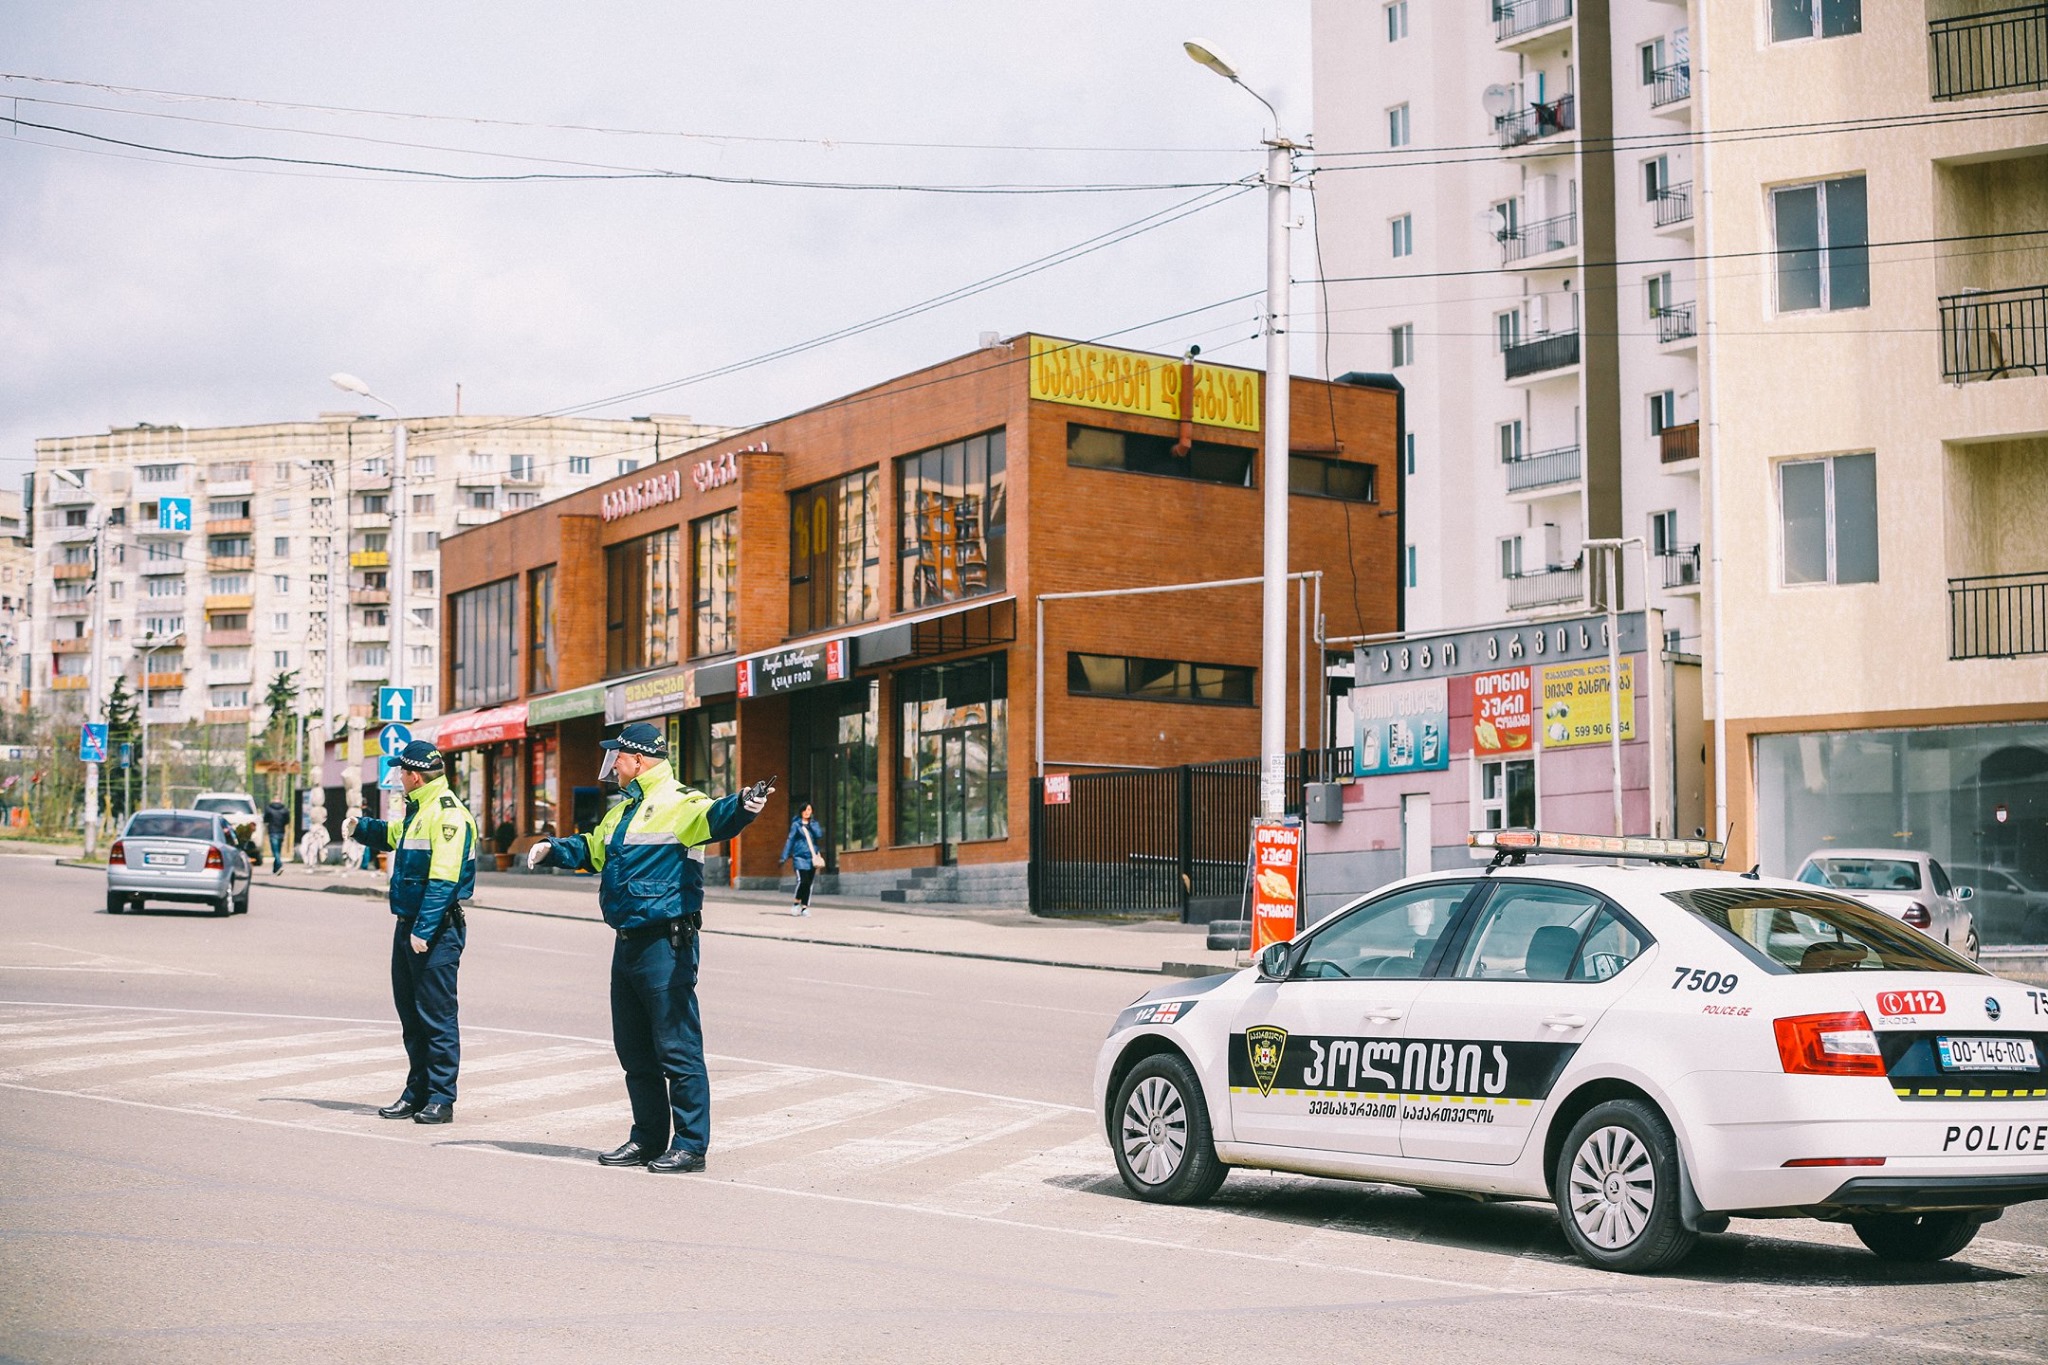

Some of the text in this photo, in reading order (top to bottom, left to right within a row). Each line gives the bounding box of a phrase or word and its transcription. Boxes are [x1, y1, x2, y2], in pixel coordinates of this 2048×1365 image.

[1037, 341, 1254, 426] საბანკეტო დრბაზი
[1381, 642, 1457, 672] ავტო
[771, 670, 812, 690] ASIAN FOOD
[1475, 670, 1530, 696] თონის
[1545, 681, 1574, 699] ცივად
[1481, 694, 1525, 718] პური
[1575, 725, 1591, 738] 599
[1593, 724, 1604, 736] 90
[1257, 829, 1298, 846] თონის
[1261, 847, 1293, 865] პური
[1671, 966, 1739, 995] 7509
[1702, 1005, 1752, 1017] POLICE.GE
[1903, 991, 1942, 1012] 112
[1134, 1007, 1156, 1023] 112
[1303, 1039, 1509, 1094] პოლიცია
[1309, 1100, 1494, 1124] ვემსახურებით საქართველოს
[1942, 1125, 2048, 1152] POLICE
